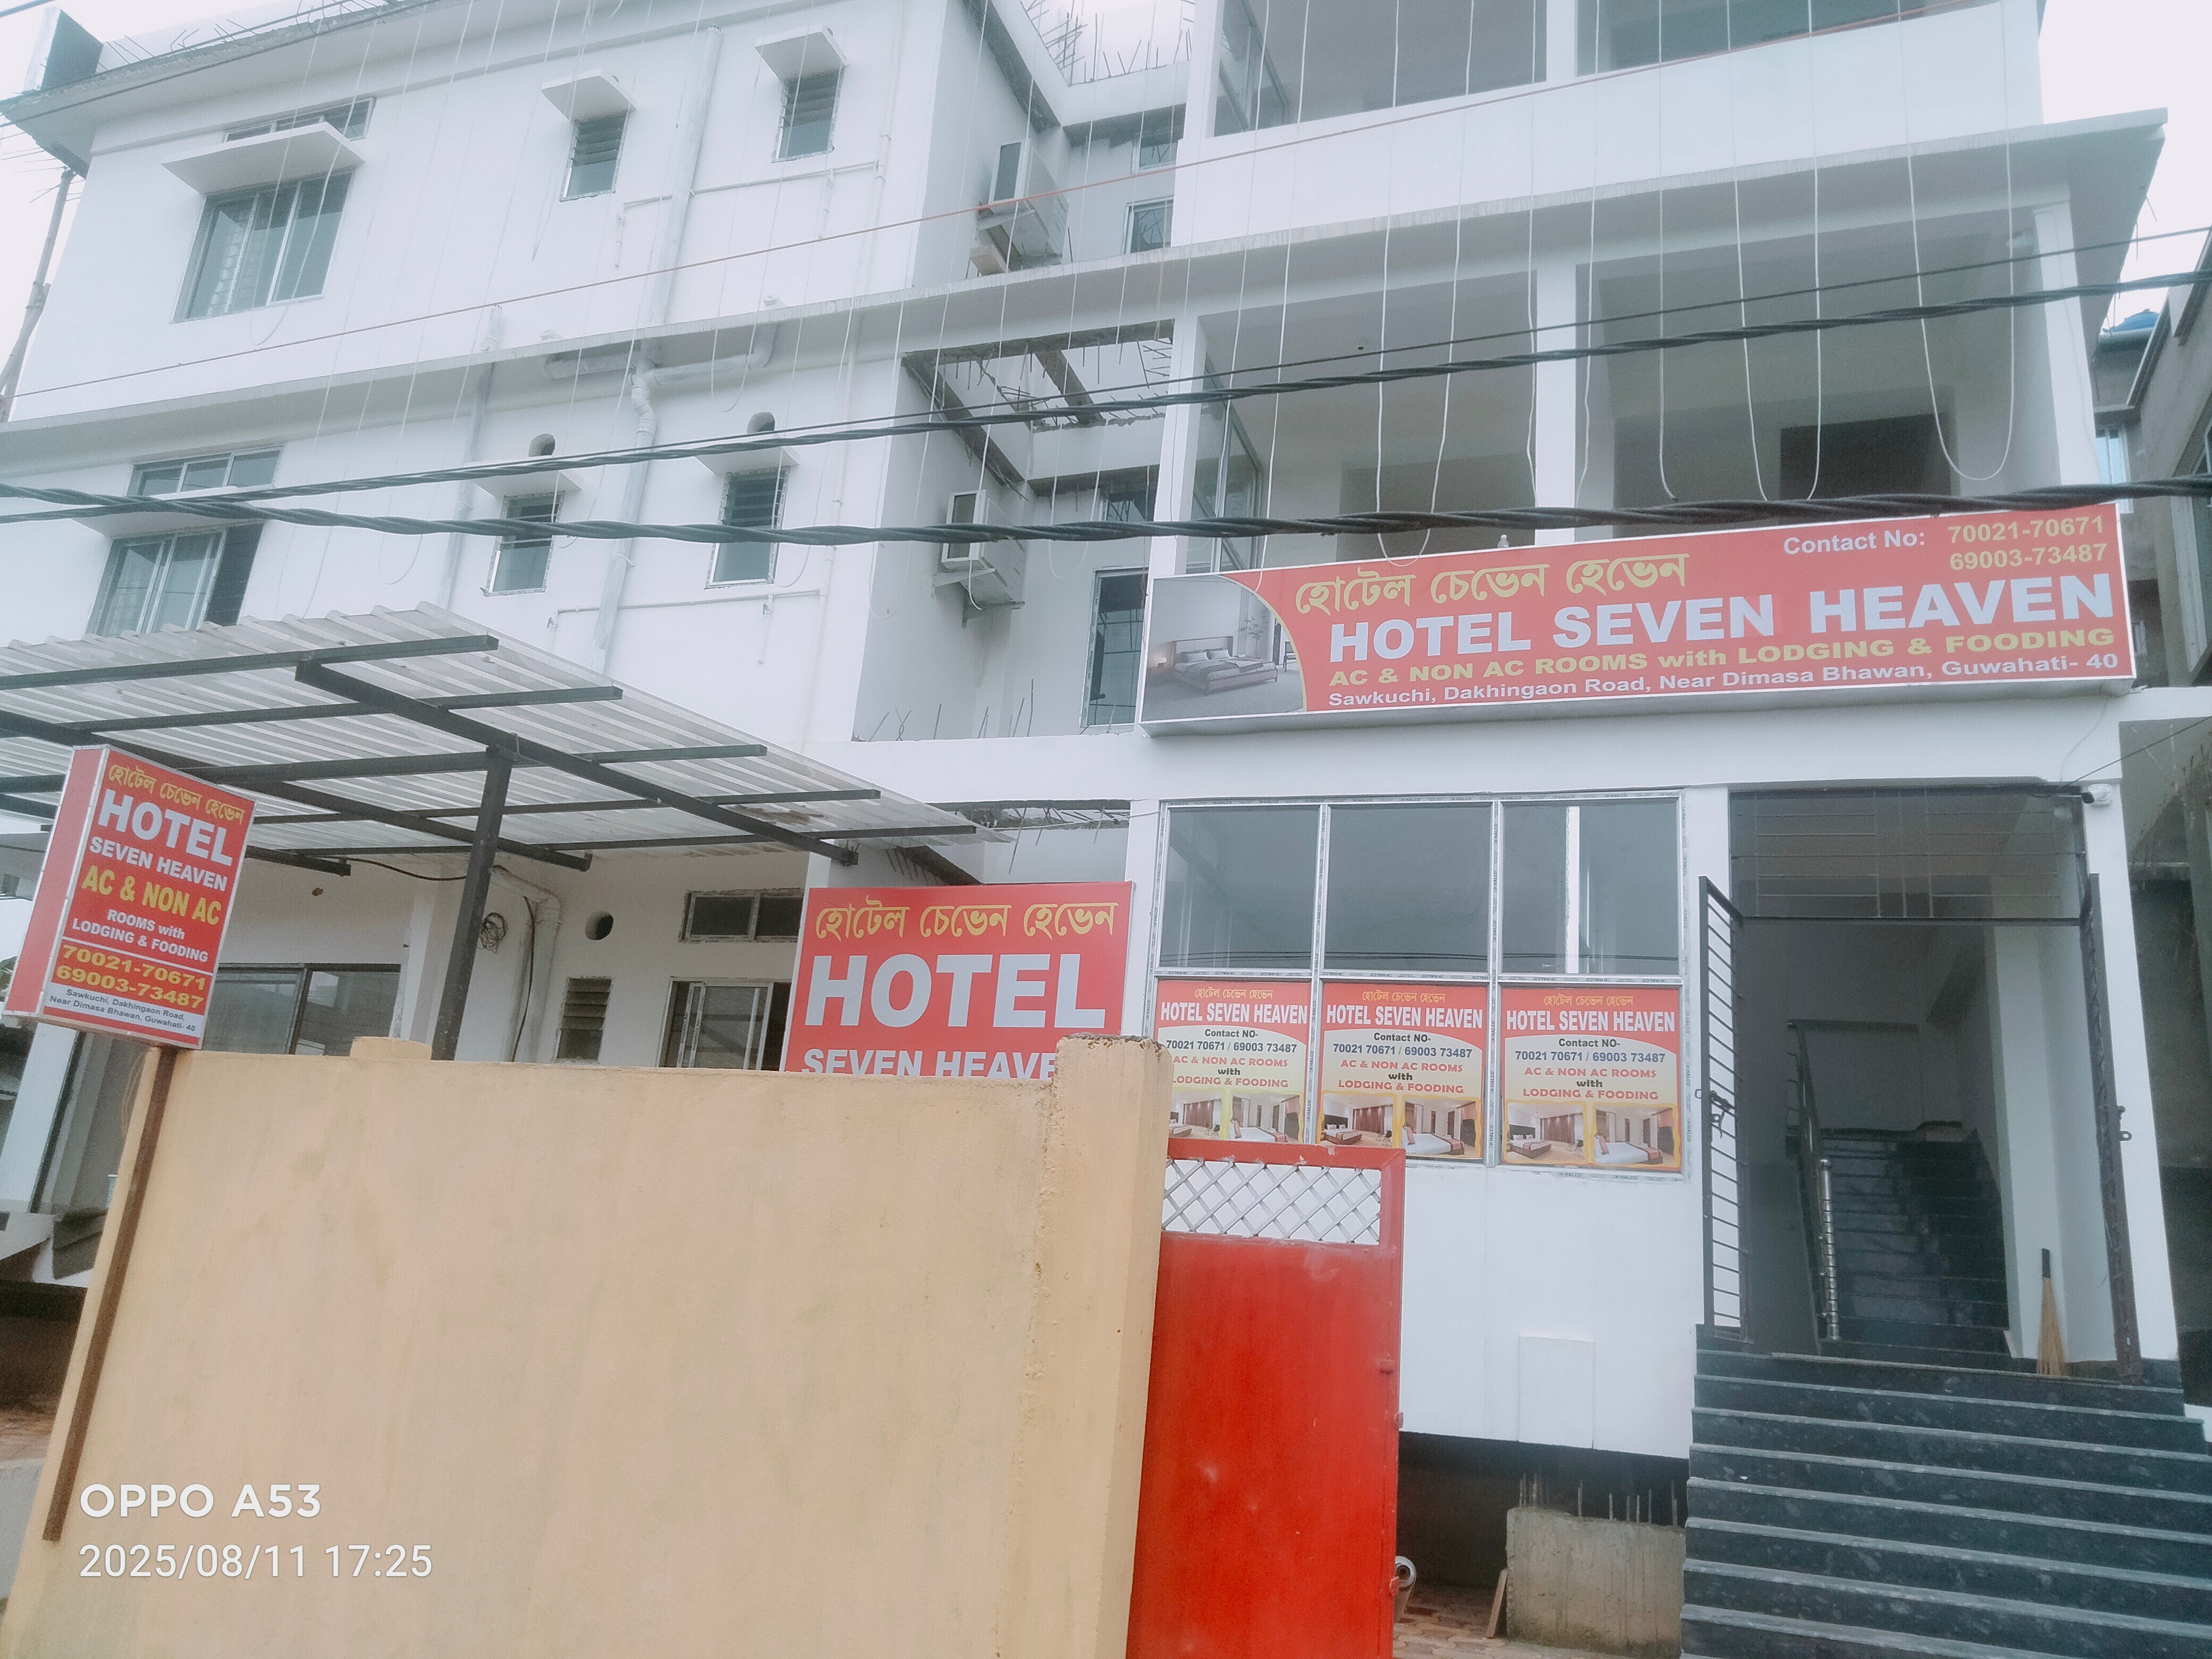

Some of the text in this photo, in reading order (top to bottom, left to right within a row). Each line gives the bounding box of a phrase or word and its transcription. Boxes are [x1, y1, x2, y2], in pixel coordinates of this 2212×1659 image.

[1784, 530, 1925, 555] Contact No:
[1948, 516, 2104, 544] 70021-70671
[1950, 543, 2108, 571] 69003-73487
[1295, 553, 1689, 615] হোটেল চেভেন হেভেন
[1330, 573, 2114, 662] HOTEL SEVEN HEAVEN
[1329, 628, 2115, 687] AC & NON AC ROOMS with LODGING & FOODING
[1329, 653, 2118, 707] Sawkuchi, Dakhingaon Road, Near Dimasa Bhawan, Guwahati- 40
[109, 765, 246, 824] হোটেল চেভেন হেভেন
[98, 789, 233, 866] HOTEL
[90, 836, 228, 891] SEVEN HEAVEN
[82, 866, 222, 925] AC & NON AC
[107, 909, 185, 940] ROOMS with
[816, 894, 1119, 941] হোটেল চেভেন হেভেন
[72, 918, 208, 963] LODGING & FOODING
[62, 944, 206, 991] 70021-70671
[57, 966, 204, 1009] 69003-73487
[805, 953, 1106, 1028] HOTEL
[50, 995, 70, 1008] Near
[73, 1000, 105, 1015] Dimasa
[107, 1007, 141, 1023] Bhawan,
[66, 988, 185, 1022] Sawkuchi, Dakhingaon Road,
[1160, 1002, 1308, 1024] HOTEL SEVEN HEAVEN
[1326, 1005, 1483, 1028] HOTEL SEVEN HEAVEN
[1205, 1029, 1259, 1038] Contact NO-
[1506, 1010, 1675, 1032] HOTEL SEVEN HEAVEN
[1166, 1040, 1194, 1050] 70021
[1197, 1041, 1225, 1051] 70671
[1234, 1042, 1263, 1052] 69003
[1267, 1043, 1297, 1053] 73487
[1334, 1044, 1362, 1053] 70021
[1366, 1044, 1396, 1054] 70671
[1405, 1046, 1436, 1056] 69003
[1440, 1048, 1472, 1058] 73487
[1374, 1033, 1431, 1042] Contact NO-
[1559, 1038, 1598, 1048] Contact
[801, 1049, 1055, 1079] SEVEN HEAVE
[1249, 1058, 1288, 1067] ROOMS
[1371, 1060, 1398, 1069] NON
[1402, 1062, 1418, 1070] AC
[1421, 1062, 1463, 1073] ROOMS
[1515, 1051, 1547, 1060] 70021
[1551, 1052, 1582, 1061] 70671
[1593, 1052, 1627, 1061] 69003
[1631, 1053, 1665, 1062] 73487
[1236, 1078, 1288, 1087] FOODING
[1338, 1080, 1392, 1090] LODGING
[1408, 1083, 1463, 1093] FOODING
[1558, 1068, 1586, 1076] NON
[1590, 1068, 1607, 1077] AC
[1611, 1069, 1656, 1077] ROOMS
[1523, 1088, 1581, 1097] LODGING
[1598, 1090, 1659, 1100] FOODING
